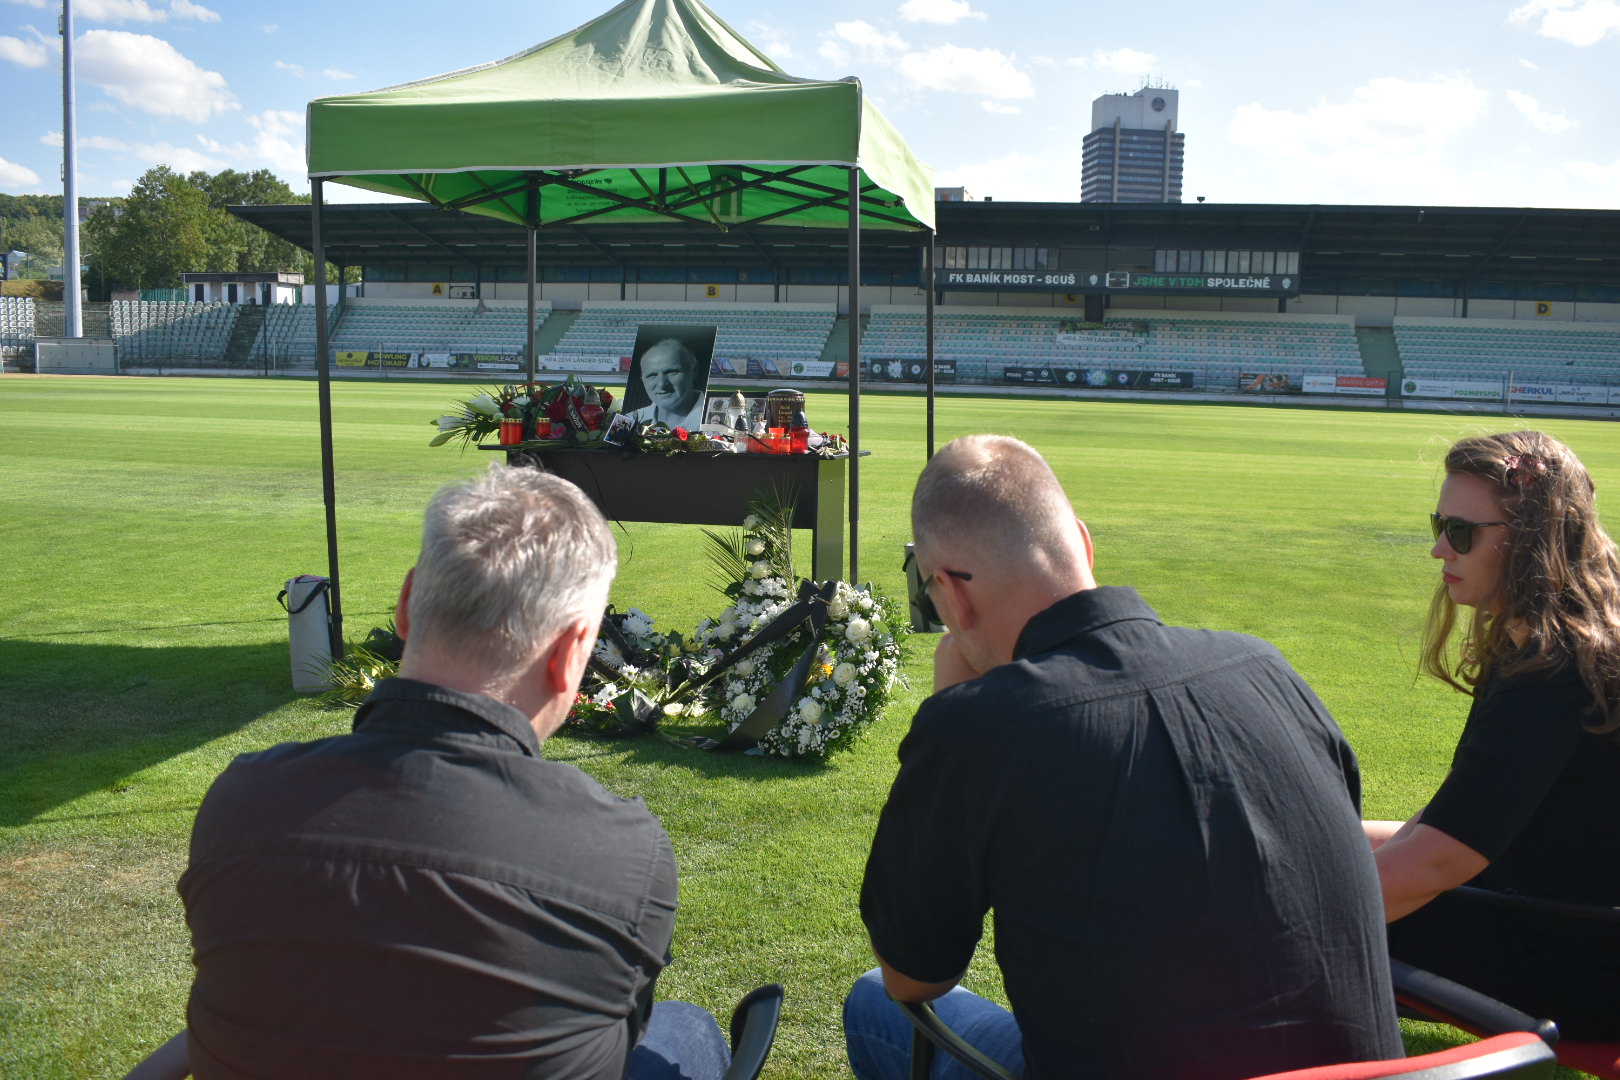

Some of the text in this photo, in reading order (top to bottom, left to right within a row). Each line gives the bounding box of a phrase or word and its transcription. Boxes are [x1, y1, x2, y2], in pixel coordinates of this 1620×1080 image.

[949, 273, 964, 283] FK
[966, 271, 1001, 284] BANÍK
[1003, 273, 1035, 284] MOST
[1133, 276, 1166, 287] JSME
[1168, 277, 1177, 287] V
[1207, 276, 1271, 289] SPOLEČNĚ
[433, 284, 442, 294] A
[708, 286, 717, 296] B
[1537, 303, 1548, 314] D
[373, 352, 407, 360] BOWLING
